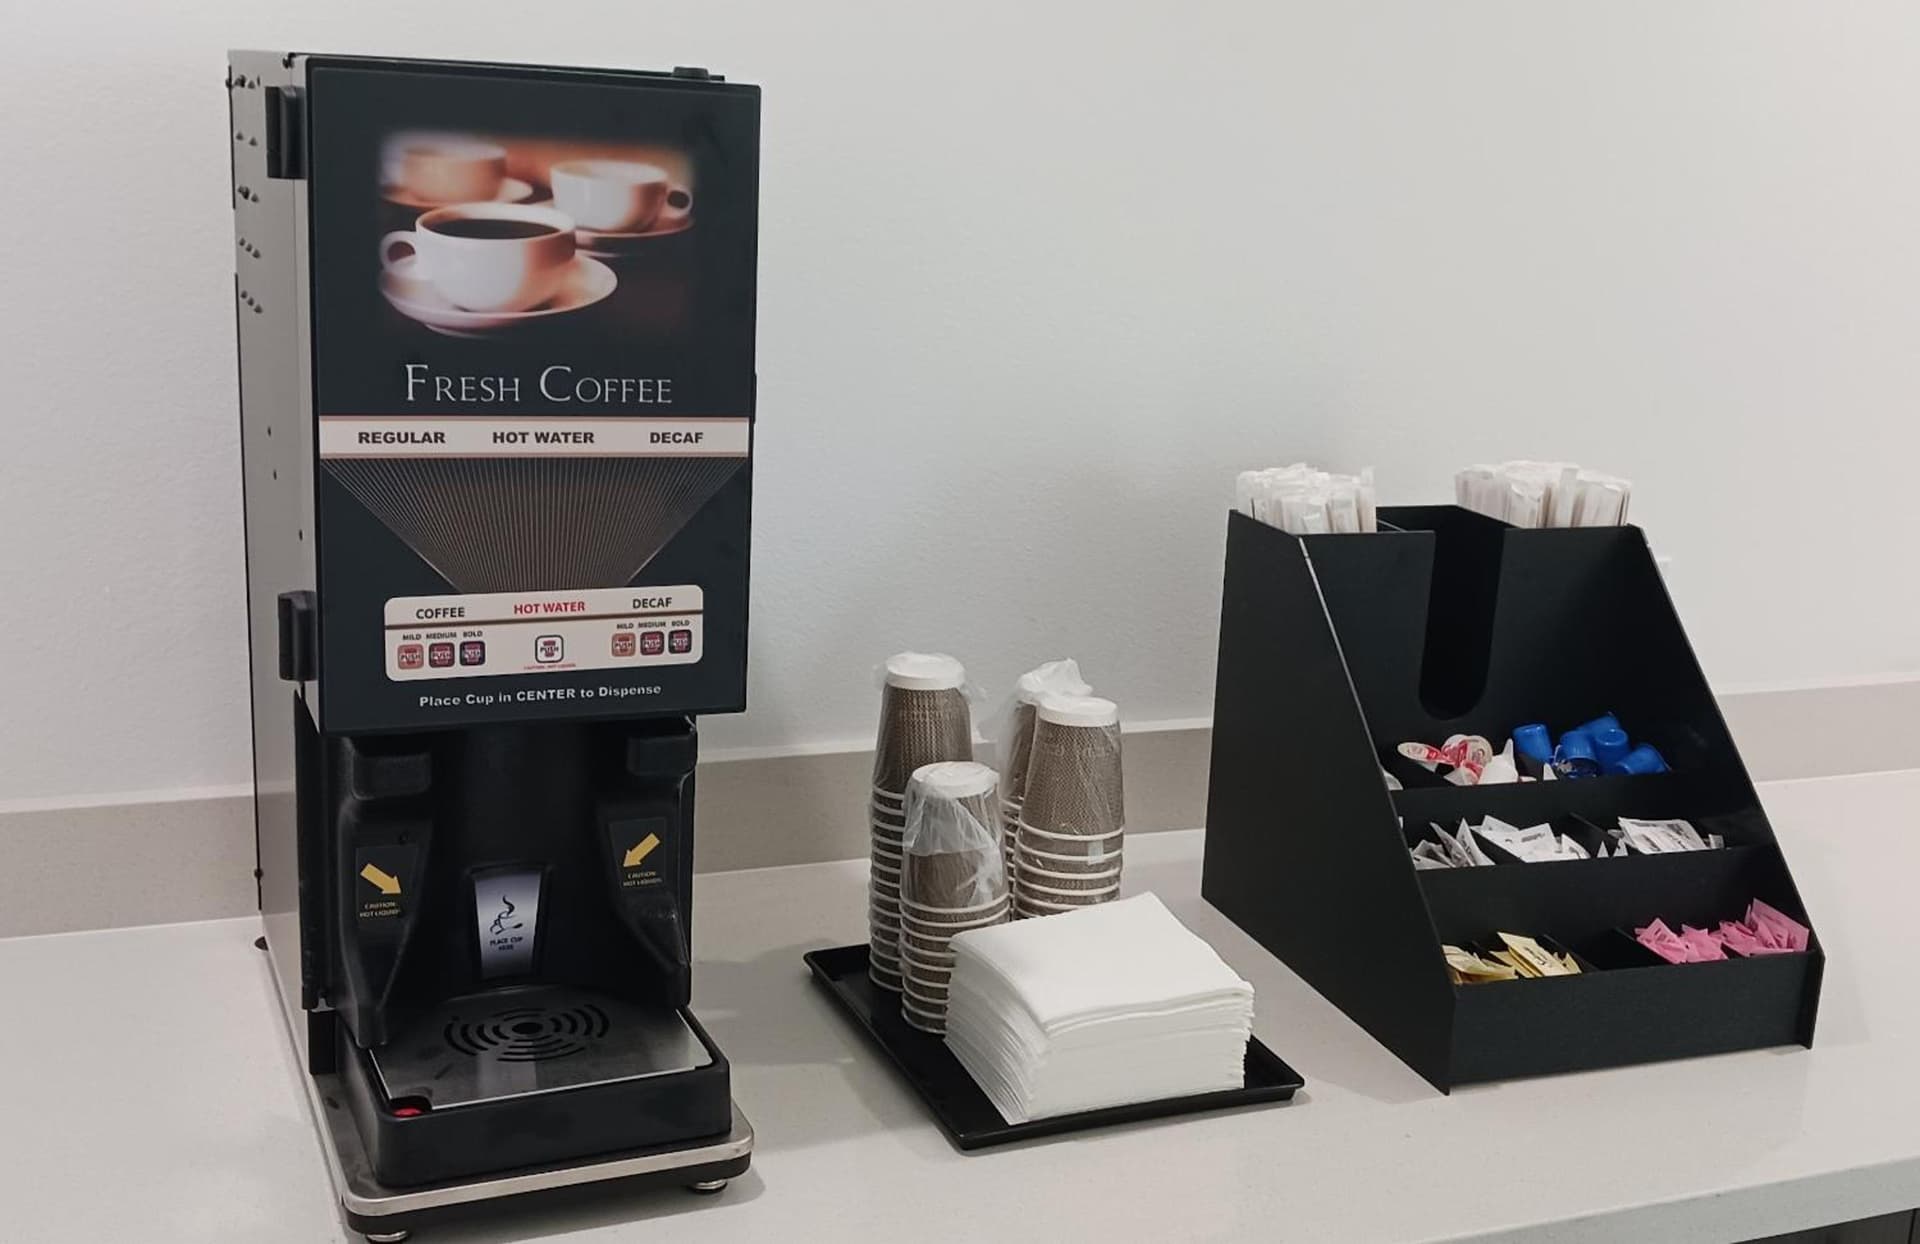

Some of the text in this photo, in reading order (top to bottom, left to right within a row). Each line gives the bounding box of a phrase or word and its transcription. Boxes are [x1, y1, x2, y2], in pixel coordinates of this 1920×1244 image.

[357, 431, 446, 445] REGULAR
[492, 431, 595, 445] HOT WATER
[649, 431, 704, 445] DECAF
[513, 601, 586, 615] HOT WATER
[632, 597, 673, 609] DECAF
[415, 606, 465, 620] COFFEE
[402, 630, 483, 641] MILD MEDIUM BOLD
[419, 696, 461, 707] Place
[465, 694, 494, 706] Cup
[516, 688, 576, 702] CENTER
[580, 688, 594, 698] to
[599, 684, 662, 698] Dispense
